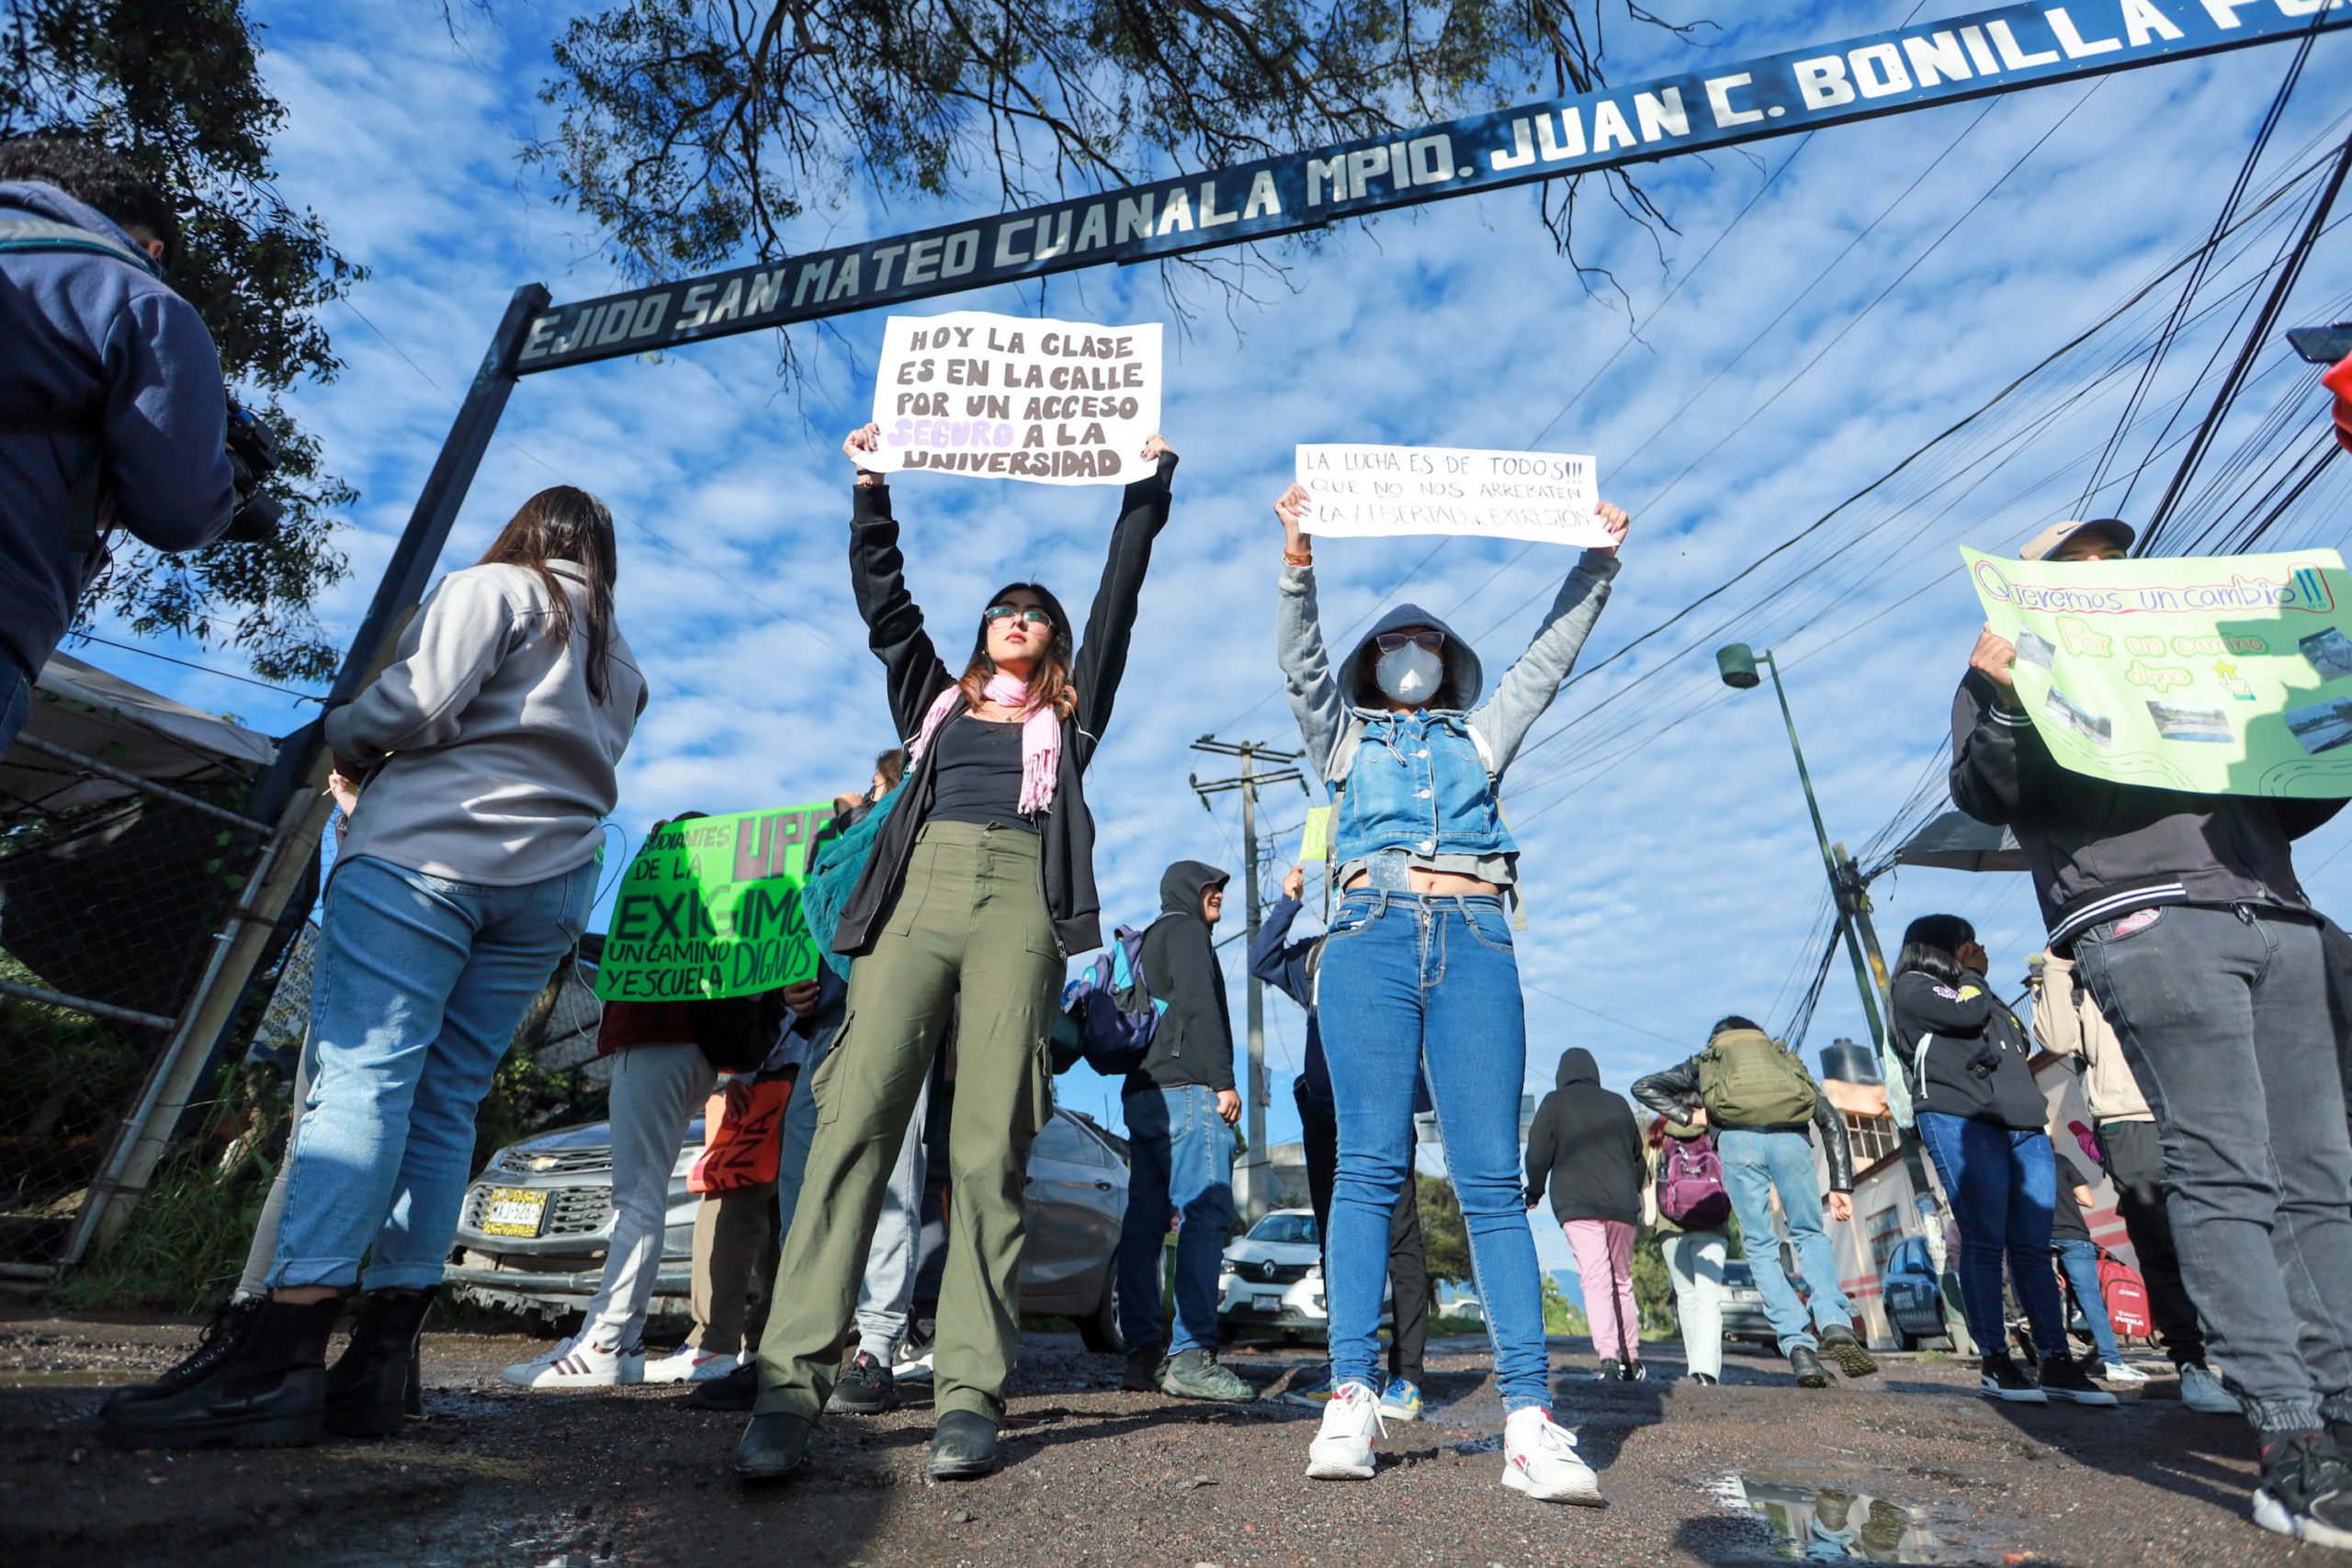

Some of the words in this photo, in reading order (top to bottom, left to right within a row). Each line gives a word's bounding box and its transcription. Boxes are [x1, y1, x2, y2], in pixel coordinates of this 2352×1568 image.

[518, 293, 668, 362] EJIDO
[675, 269, 786, 331] SAN
[791, 228, 981, 308] MATEO
[992, 169, 1283, 268] CUANALA
[1306, 133, 1475, 208] MPIO.
[1490, 86, 1690, 172] JUAN
[1704, 72, 1786, 130] C.
[1792, 0, 2186, 112] BONILLA
[910, 327, 975, 352] HOY
[988, 328, 1025, 354] LA
[1041, 333, 1133, 360] CLASE
[897, 359, 934, 386] ES
[946, 359, 989, 387] EN
[1004, 363, 1044, 389] LA
[1049, 363, 1144, 391] CALLE
[897, 392, 949, 417] POR
[966, 395, 1010, 419] UN
[1023, 396, 1139, 420] ACCESO
[887, 419, 1015, 448] SEGURO
[1023, 424, 1045, 448] A
[1057, 423, 1106, 446] LA
[902, 449, 1122, 478] UNIVERSIDAD
[1306, 453, 1330, 471] LA
[1344, 453, 1401, 472] LUCHA
[1409, 454, 1433, 475] ES
[1446, 456, 1470, 475] DE
[1311, 478, 1362, 494] QUE
[1374, 480, 1404, 498] NO
[1420, 480, 1464, 498] NOS
[1479, 482, 1581, 499] ARREBATEN
[1319, 504, 1348, 524] LA
[1355, 504, 1467, 525] LIBERTAD
[1976, 562, 2123, 610] Queremos
[2140, 589, 2176, 611] un
[2060, 619, 2110, 654] Por
[2127, 637, 2163, 654] un
[2175, 636, 2266, 653] camino
[2130, 663, 2190, 687] digno
[632, 858, 661, 881] DE
[673, 854, 702, 880] LA
[608, 942, 645, 964] UN
[646, 940, 730, 964] CAMINO
[732, 935, 811, 988] DIGNOS
